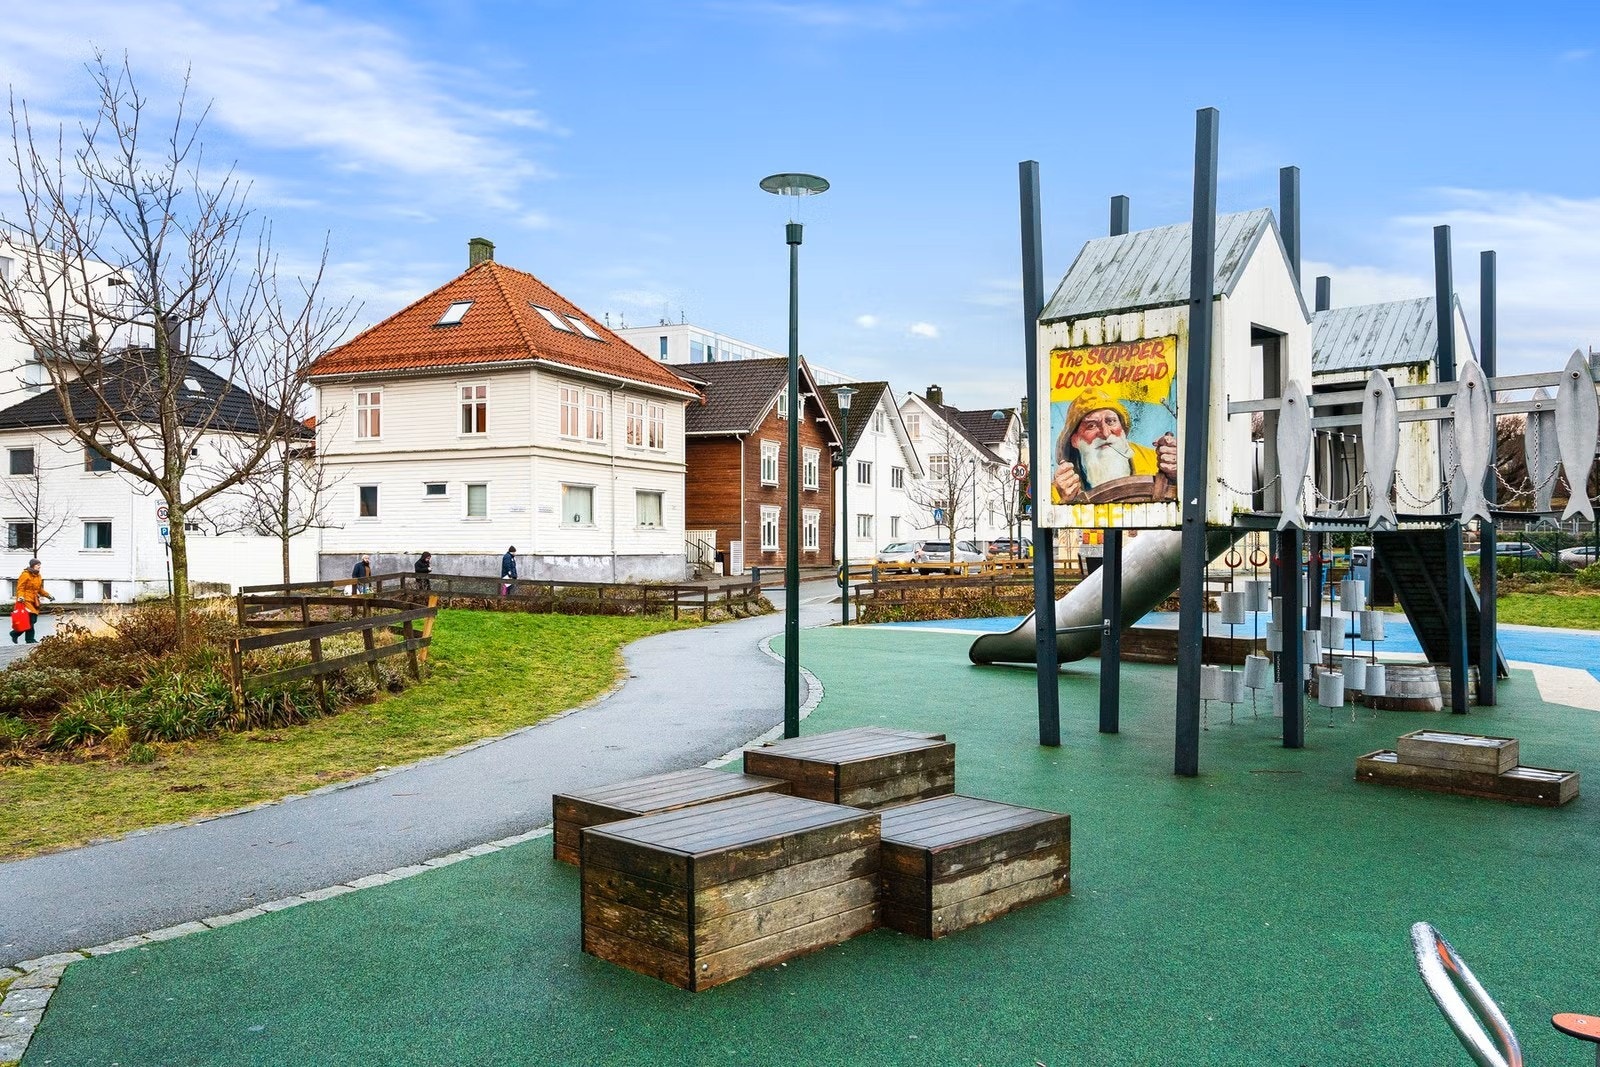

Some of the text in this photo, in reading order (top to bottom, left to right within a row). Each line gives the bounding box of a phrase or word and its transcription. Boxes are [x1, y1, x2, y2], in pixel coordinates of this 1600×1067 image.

[1056, 342, 1166, 368] The SKIPPER
[1055, 362, 1169, 389] LOOKS AHEAD
